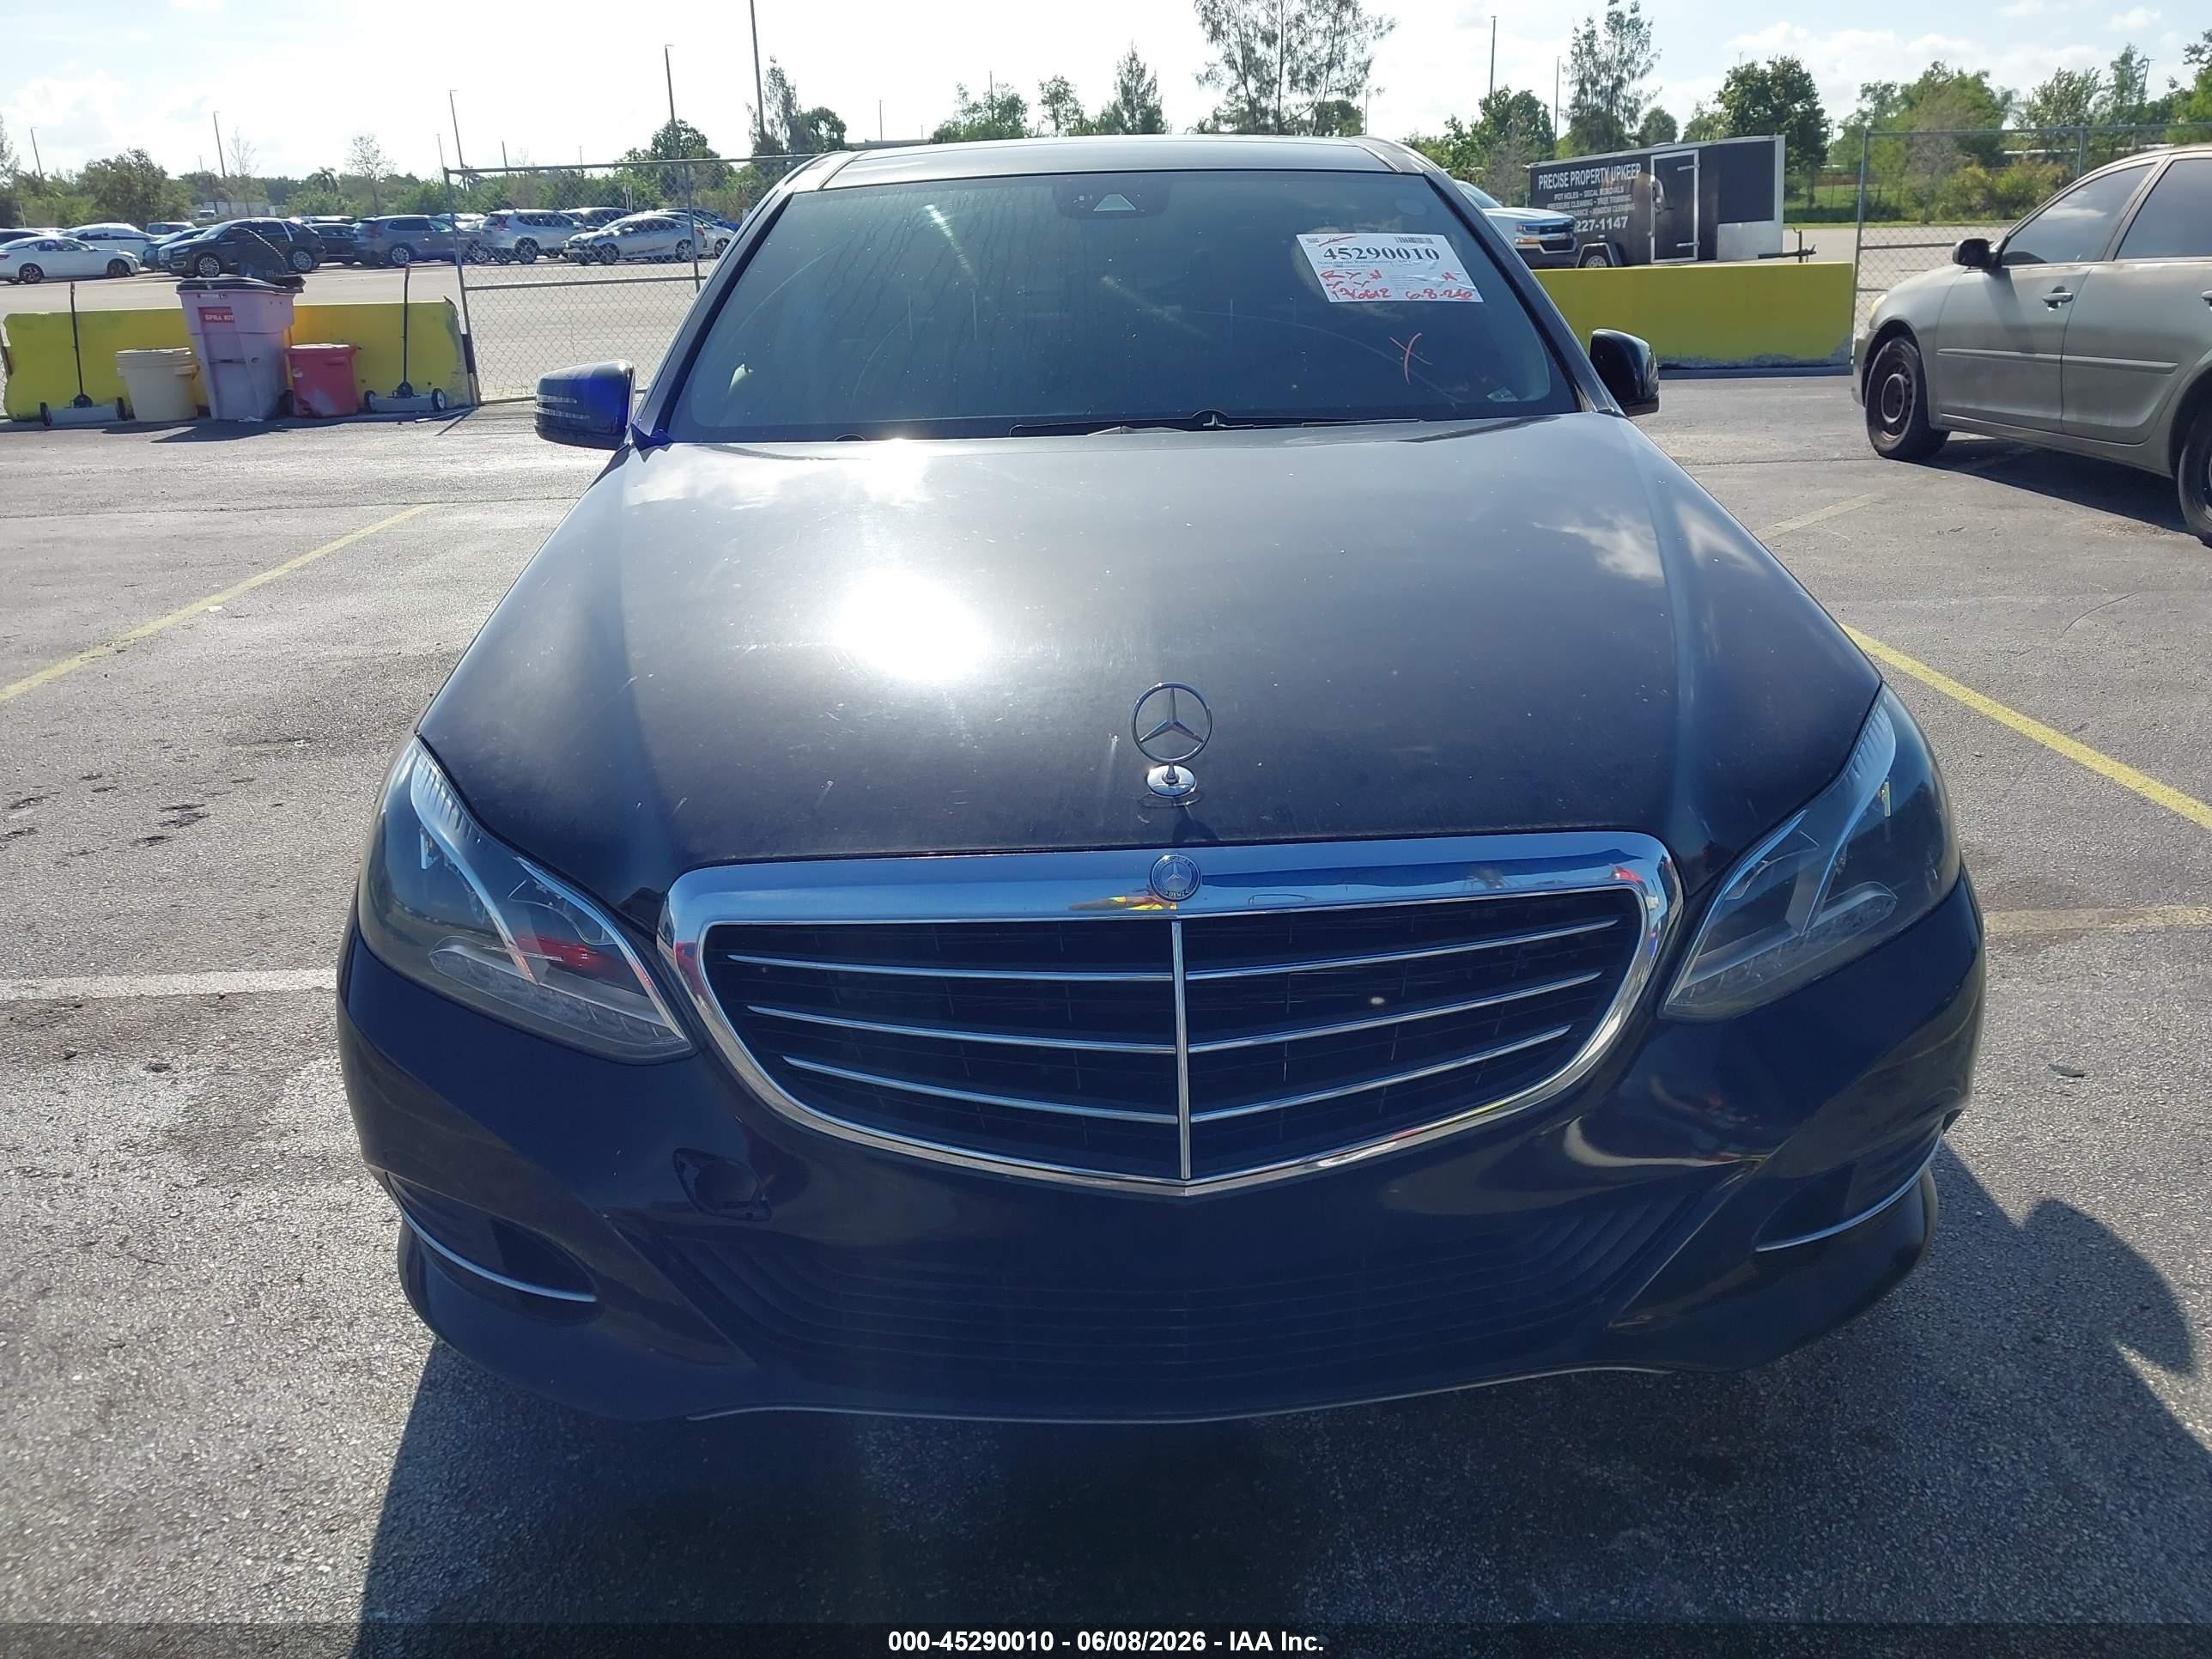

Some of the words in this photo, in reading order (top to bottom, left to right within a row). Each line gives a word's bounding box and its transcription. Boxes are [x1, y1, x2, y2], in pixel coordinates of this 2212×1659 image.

[1538, 172, 1570, 190] PRECISE
[1570, 167, 1610, 186] PROPERTY
[1611, 163, 1642, 182] UPKEEP
[1571, 199, 1594, 208] CLEANING
[1612, 203, 1636, 212] CLEANING
[1323, 246, 1440, 260] 45290010
